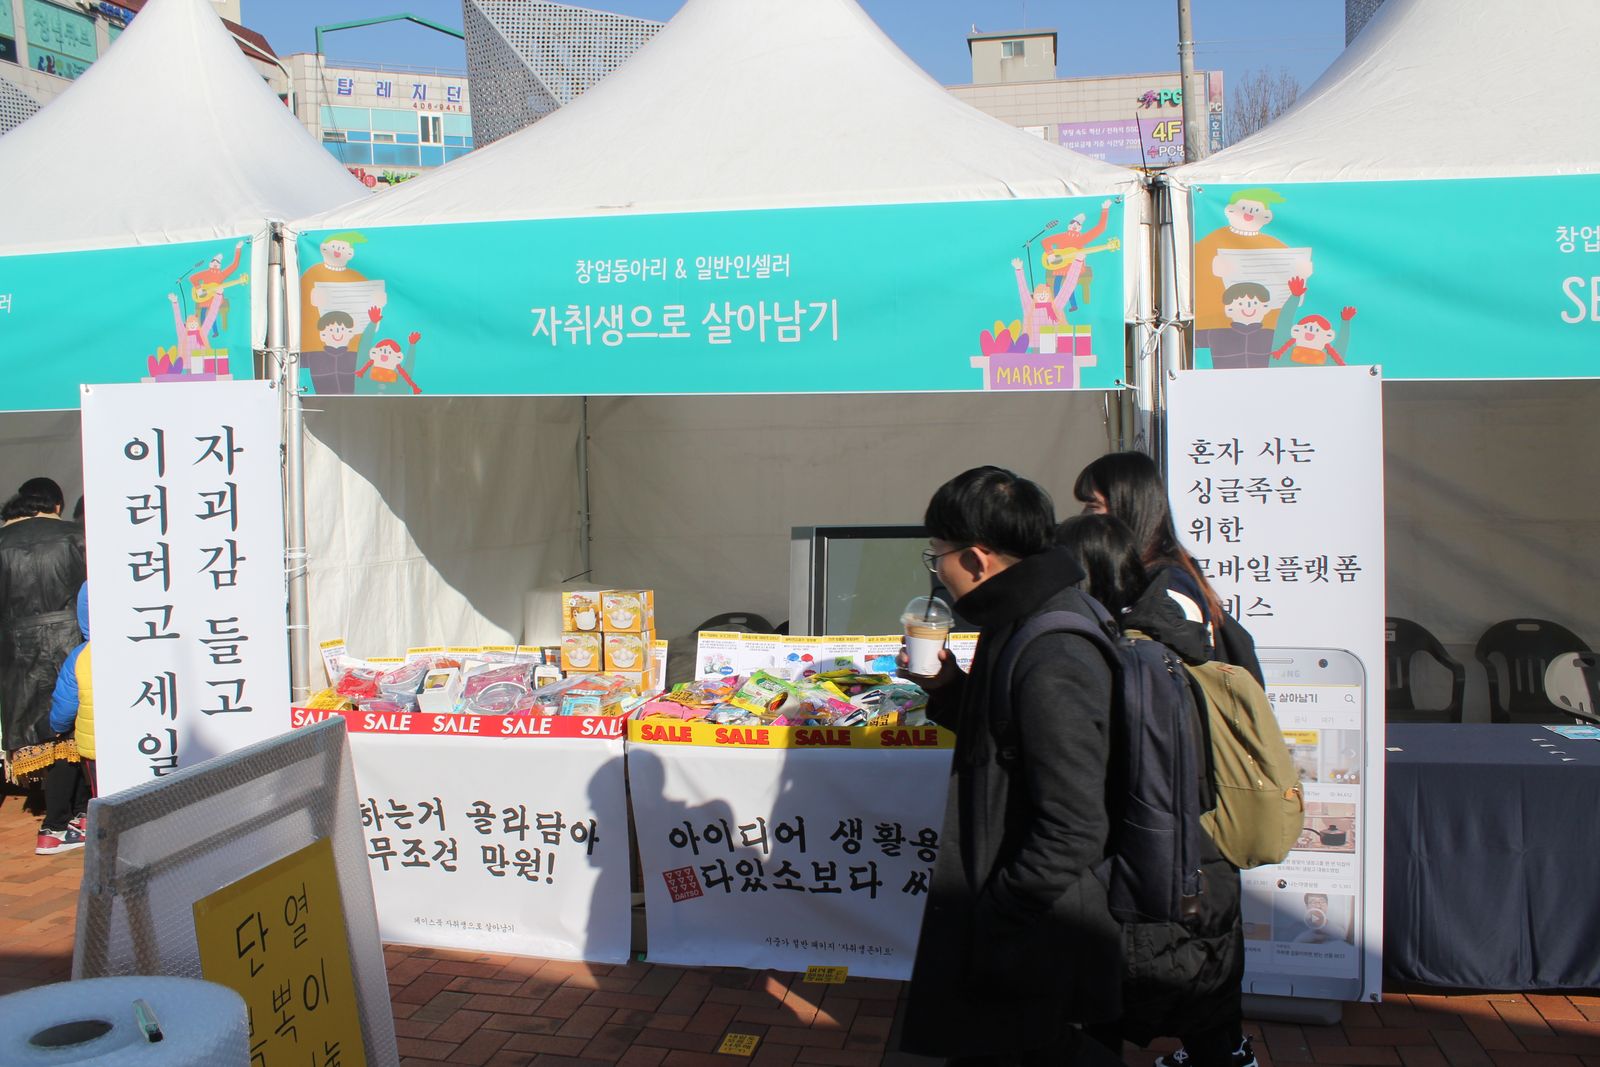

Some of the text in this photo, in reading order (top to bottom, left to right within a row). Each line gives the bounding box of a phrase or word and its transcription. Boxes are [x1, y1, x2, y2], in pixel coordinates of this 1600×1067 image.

[1152, 121, 1182, 142] 4F
[1556, 225, 1600, 253] 창업
[575, 253, 790, 284] 창업동아리 & 일반인셀러
[531, 299, 839, 347] 자취생으로 살아남기
[996, 364, 1065, 386] MARKET
[1187, 437, 1315, 466] 혼자 사는
[1186, 476, 1302, 505] 싱글족을
[192, 425, 247, 590] 자괴감
[124, 427, 181, 643] 이러려고
[1188, 516, 1244, 544] 위한
[1279, 693, 1318, 704] 살아남기
[364, 713, 412, 732] SALE
[432, 715, 481, 734] SALE
[501, 717, 552, 735] SALE
[580, 716, 624, 736] SALE
[641, 724, 938, 746] SALE SALE SALE SALE
[466, 800, 600, 856] 골라담아
[668, 816, 939, 863] 아이디어 생활용
[367, 836, 556, 885] 무조건 만원!
[700, 858, 883, 899] 다있소보다
